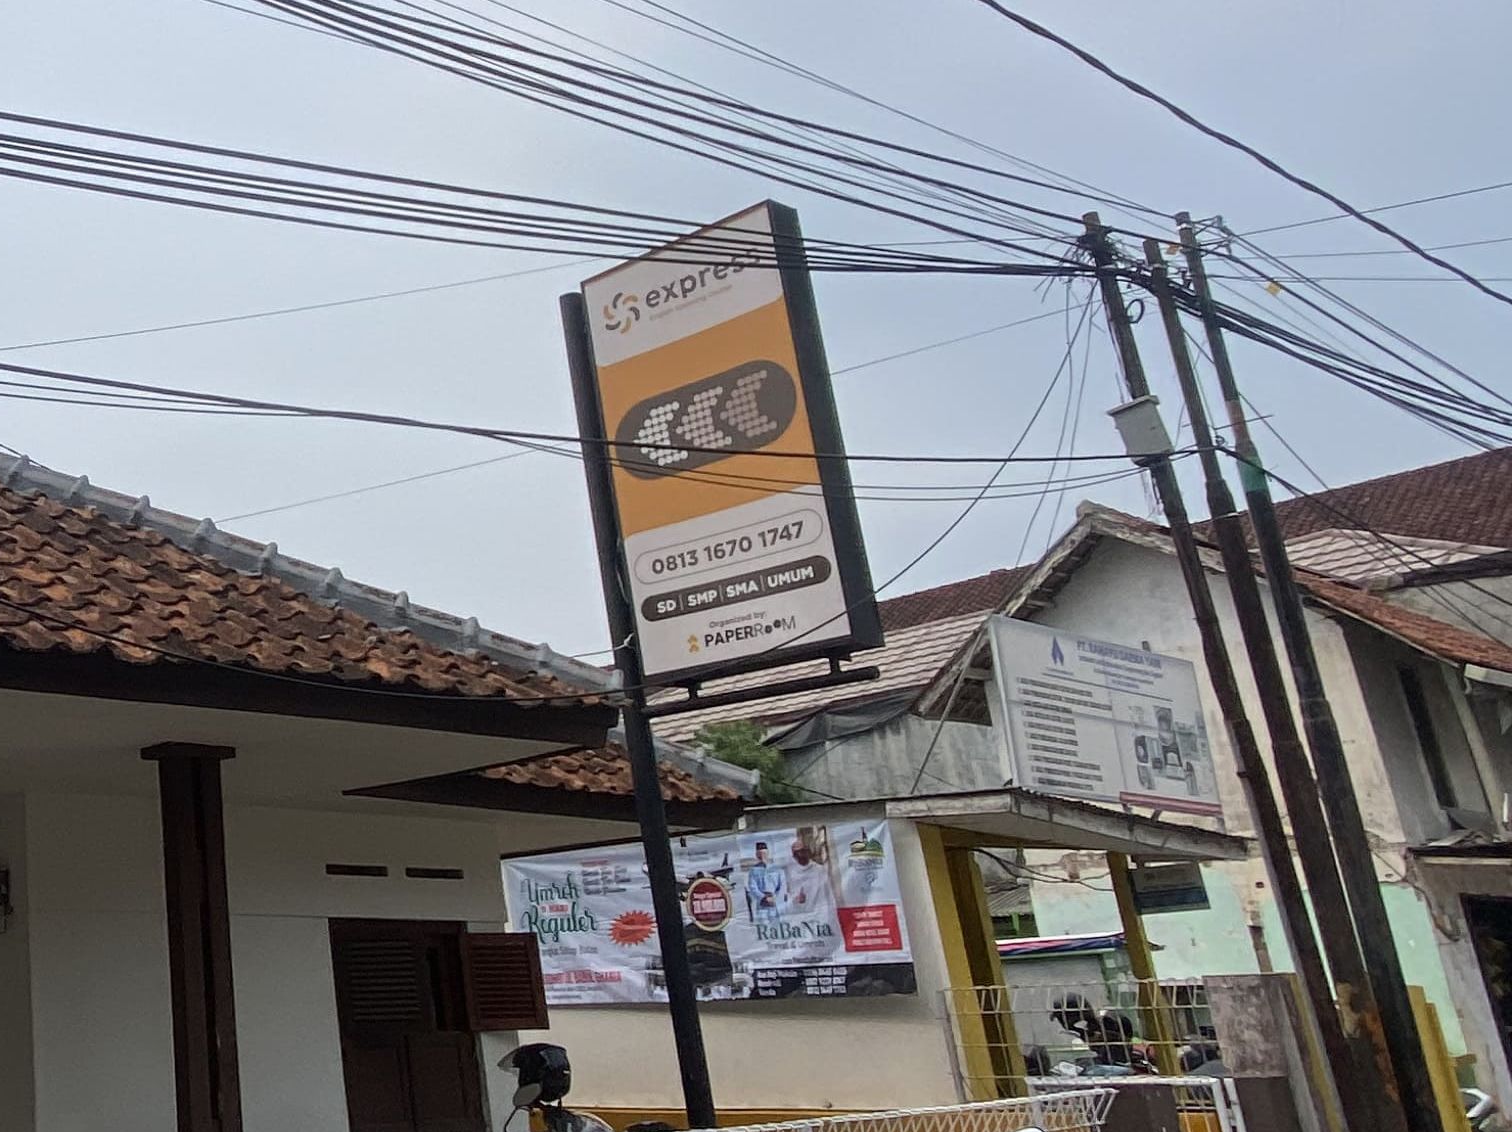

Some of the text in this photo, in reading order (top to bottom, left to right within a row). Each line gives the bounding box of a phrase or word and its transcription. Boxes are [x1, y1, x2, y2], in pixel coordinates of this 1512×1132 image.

[652, 521, 803, 574] 0813 1670 1747
[657, 566, 814, 613] SD SMP SMA UMUM
[709, 613, 751, 629] Organized
